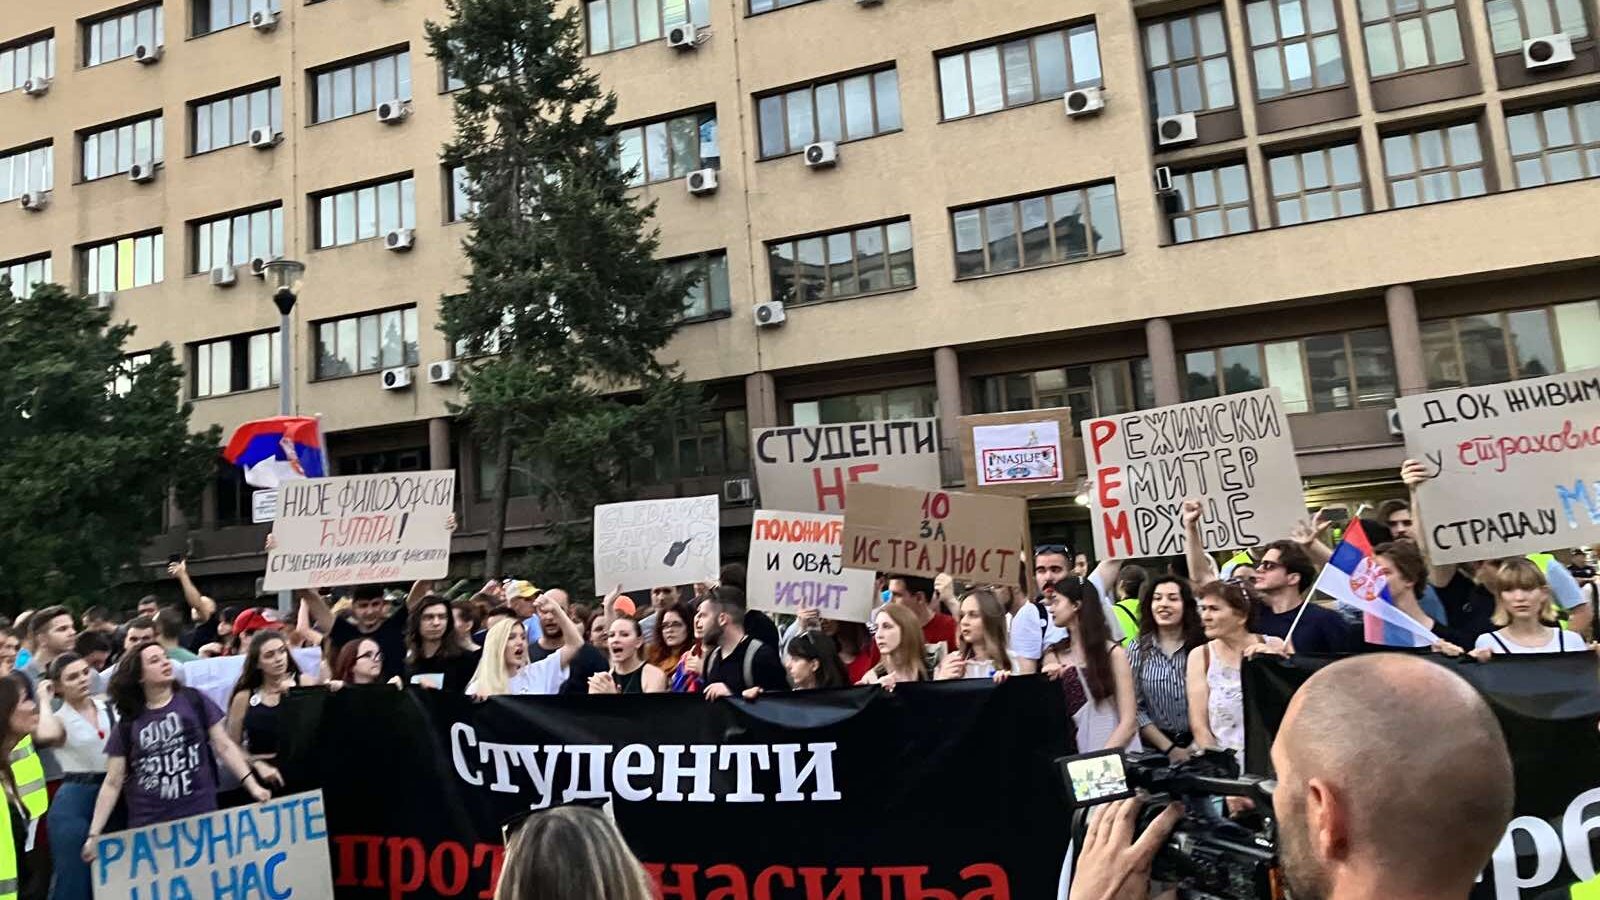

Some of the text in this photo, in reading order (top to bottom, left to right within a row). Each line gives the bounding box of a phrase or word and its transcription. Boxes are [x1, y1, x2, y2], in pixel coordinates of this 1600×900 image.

[1090, 395, 1280, 465] РЕЖИМСКИ
[1422, 393, 1499, 428] ДОК
[757, 420, 936, 464] СТУДЕНТИ
[283, 482, 333, 518] НИЈЕ
[338, 476, 454, 517] ФИЛОЗОФСКИ
[1098, 446, 1258, 509] ЕМИТЕР
[921, 491, 950, 519] 10
[919, 521, 946, 541] ЗА
[1433, 508, 1557, 550] СТРАДАЈУ
[271, 552, 332, 573] СТУДЕНТИ
[767, 552, 843, 575] И ОВАЈ
[775, 581, 848, 609] ИСПИТ
[451, 721, 842, 814] Студенти
[98, 797, 327, 885] РАЧУНАЈТЕ
[211, 851, 293, 900] НАС
